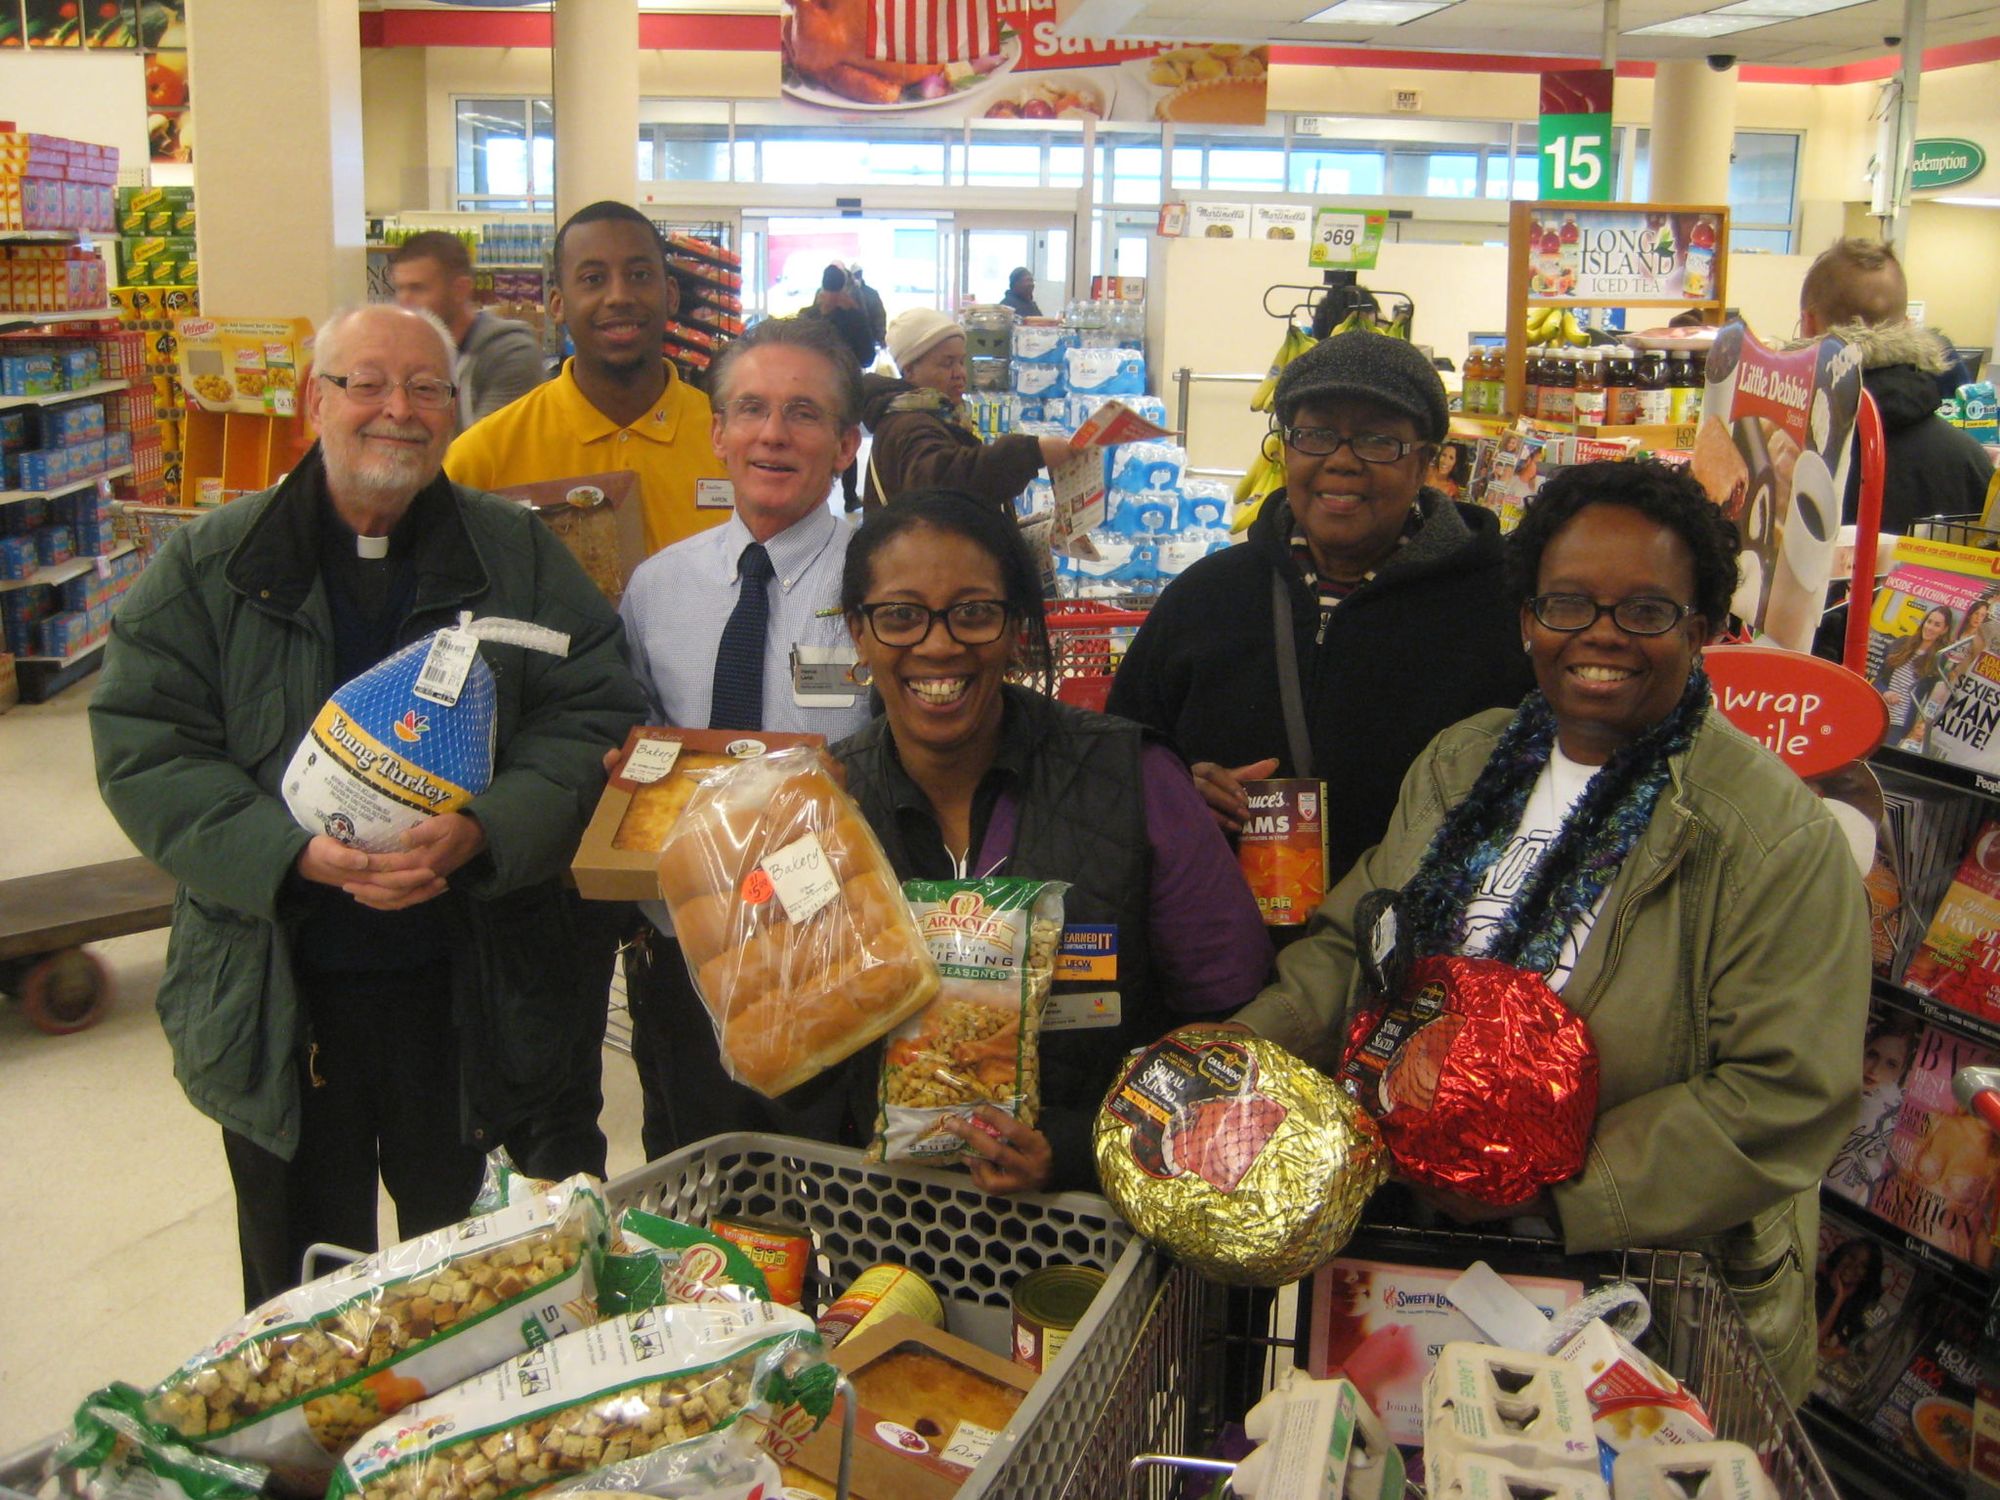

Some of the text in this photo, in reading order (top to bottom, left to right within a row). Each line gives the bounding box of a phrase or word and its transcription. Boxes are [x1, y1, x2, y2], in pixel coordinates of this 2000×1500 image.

[1398, 91, 1416, 102] EXIT
[1303, 118, 1318, 127] EXIT
[1544, 135, 1602, 190] 15
[1912, 151, 1967, 175] edemption
[1583, 229, 1657, 253] LONG
[1580, 250, 1675, 275] ISLAND
[1592, 278, 1660, 294] ICED TEA
[182, 322, 214, 337] Velveeta
[1738, 361, 1808, 411] Little Debbie
[1577, 439, 1627, 456] Woman's
[1886, 576, 1911, 593] INSIDE
[1912, 583, 1951, 605] CATCHING
[1977, 662, 2000, 682] LEVIN
[1955, 674, 2000, 707] SEXIES
[1709, 686, 1820, 726] nwrap
[1943, 693, 2000, 733] MAN
[1753, 718, 1809, 755] ile
[1933, 712, 1991, 751] ALIVE!
[327, 713, 377, 770] Young
[377, 753, 453, 806] Turkey
[637, 744, 678, 765] Bakery
[1975, 774, 2000, 794] Peop
[1246, 791, 1286, 809] ruce's
[1242, 815, 1290, 834] AMS
[769, 847, 819, 882] Bakery
[926, 914, 1000, 937] ARNOLD
[1063, 932, 1112, 950] EARNED IT
[1935, 1338, 1984, 1381] HOLID
[1386, 1400, 1408, 1413] Join
